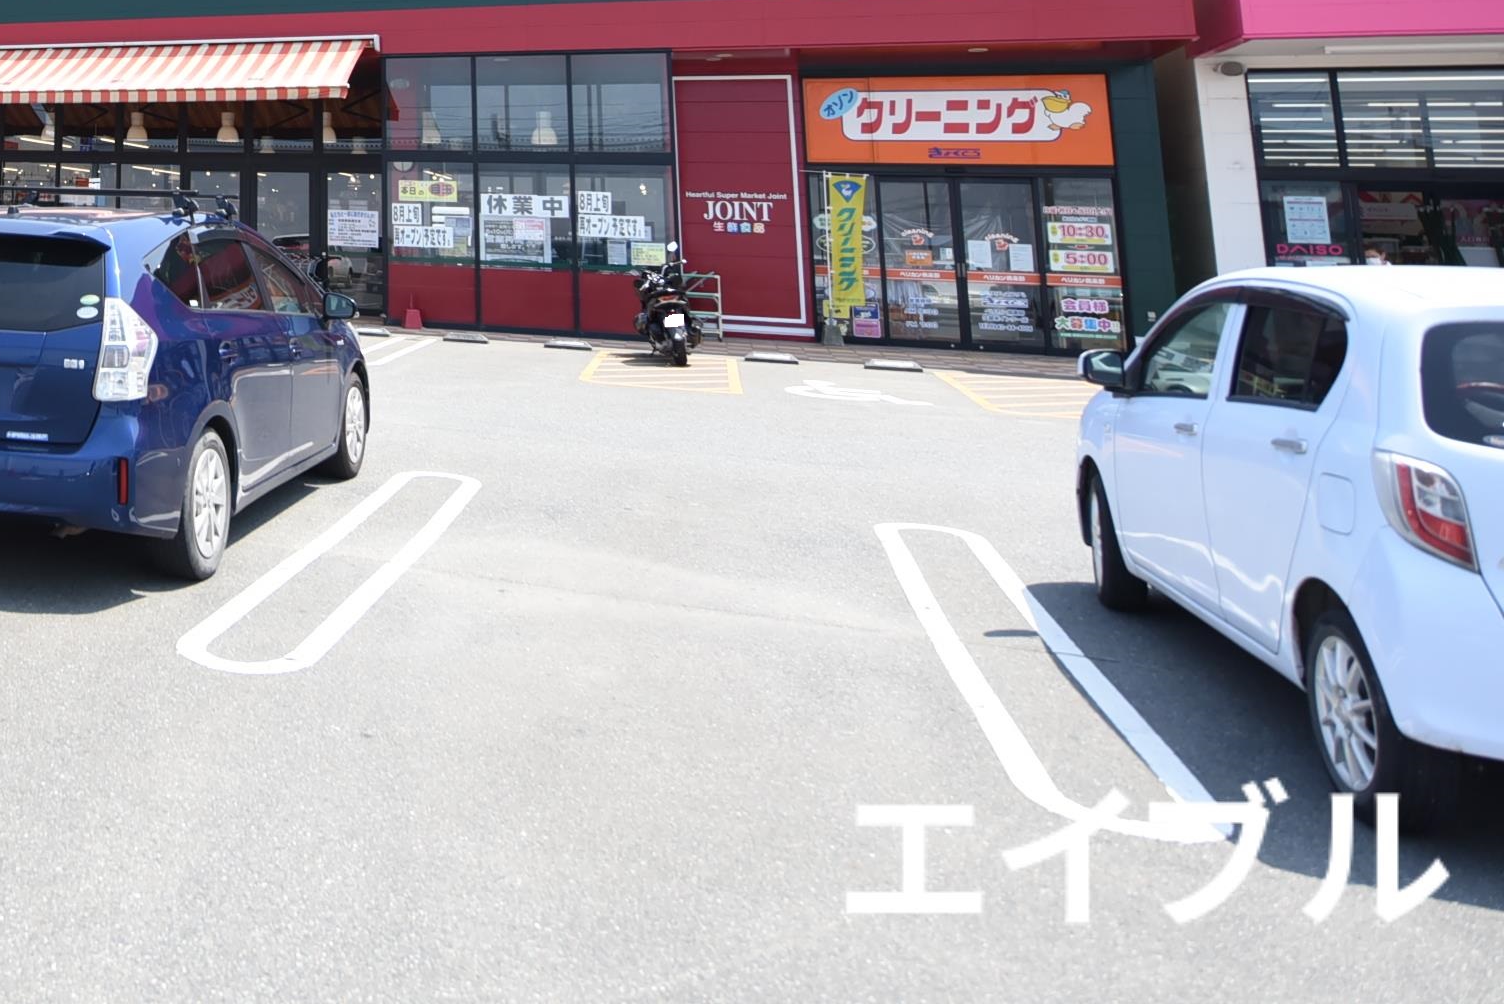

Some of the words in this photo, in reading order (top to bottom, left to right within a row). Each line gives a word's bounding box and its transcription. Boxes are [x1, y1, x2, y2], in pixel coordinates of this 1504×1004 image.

[823, 89, 855, 117] オゾン
[856, 95, 1038, 135] クリーニング
[487, 195, 563, 216] 休業中
[579, 193, 609, 213] 8月上旬
[703, 200, 773, 221] JOINT
[393, 205, 420, 223] 8月上旬
[837, 207, 857, 292] クリーニング
[1276, 244, 1344, 256] DAISO
